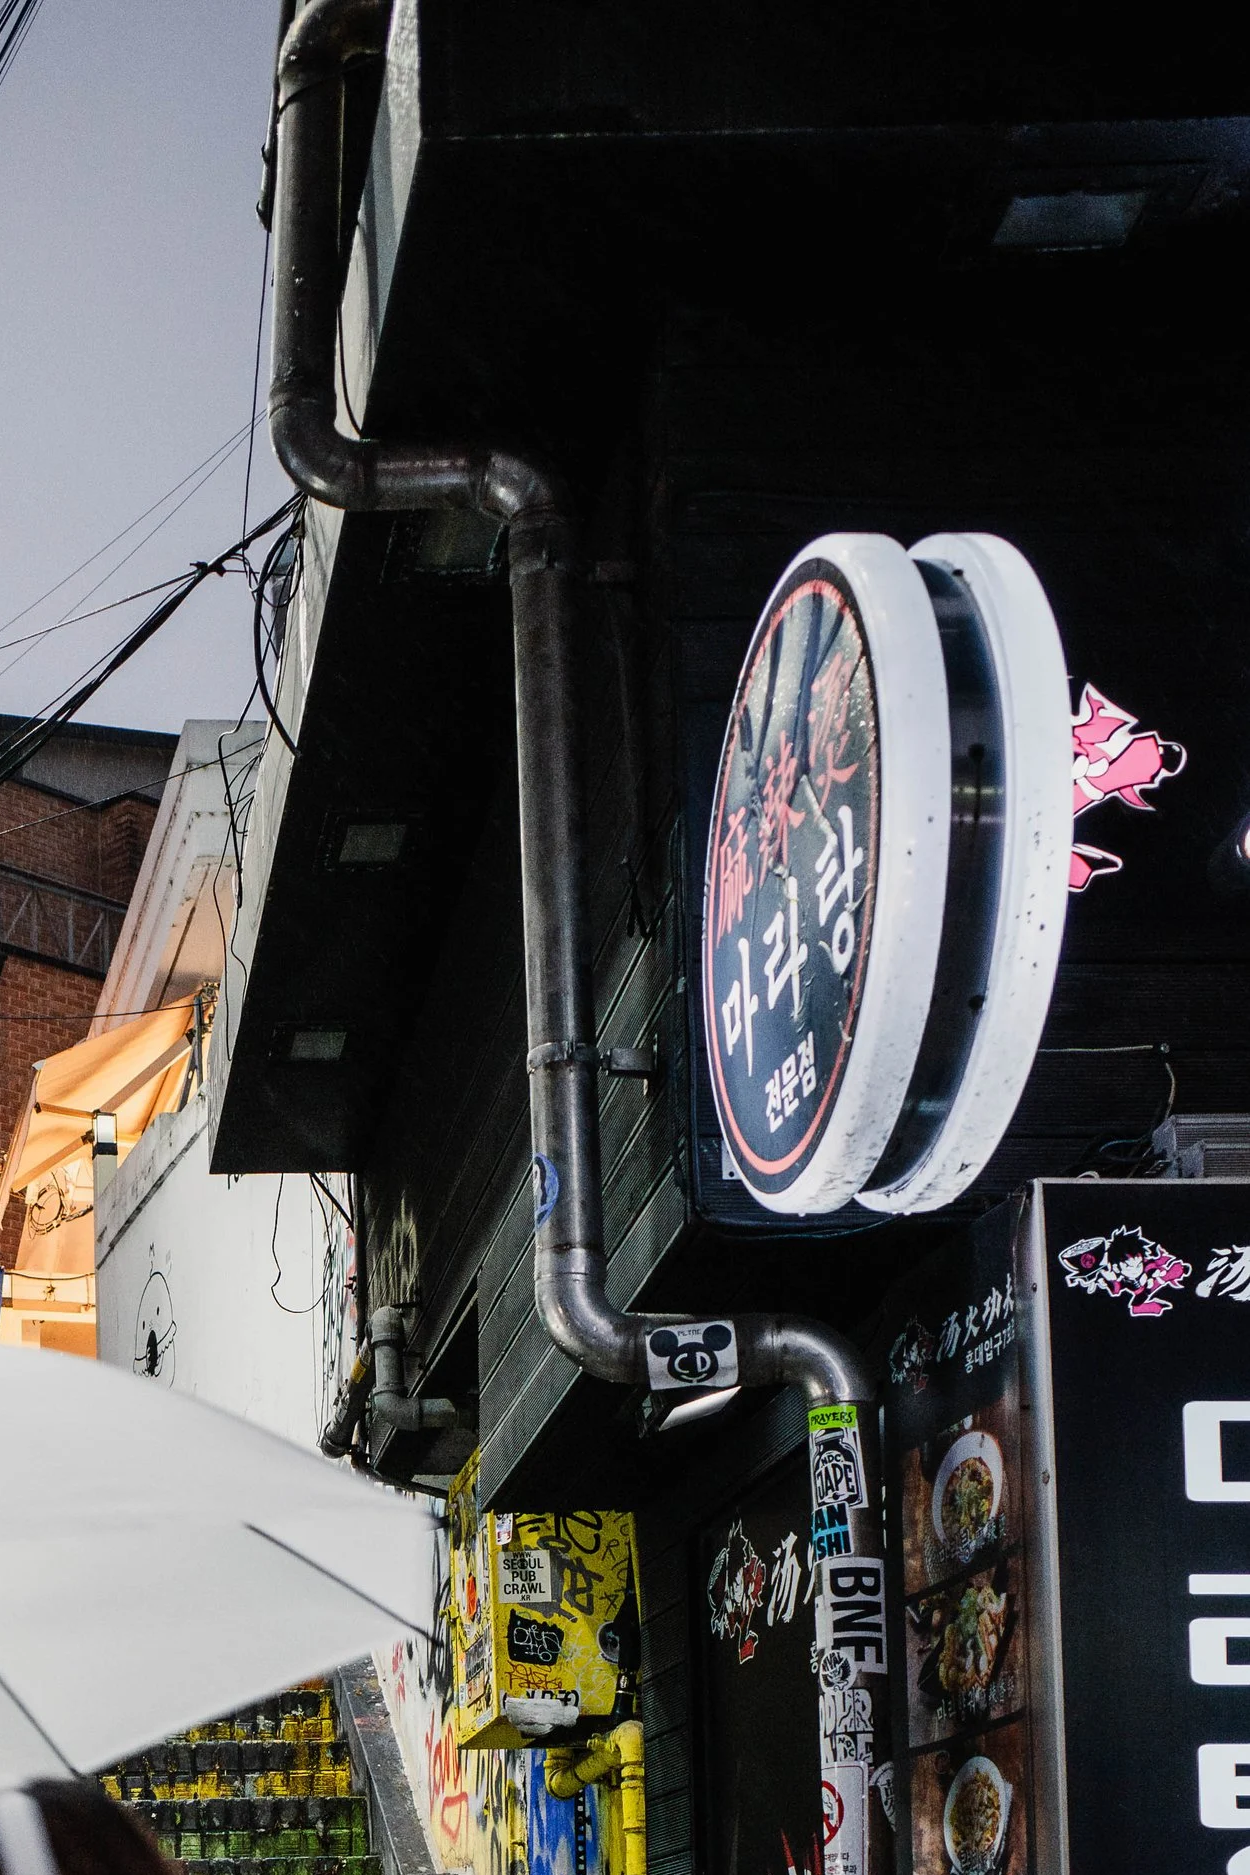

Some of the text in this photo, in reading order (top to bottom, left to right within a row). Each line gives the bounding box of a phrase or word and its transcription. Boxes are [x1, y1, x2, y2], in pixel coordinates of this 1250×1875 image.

[721, 805, 864, 1077] 마라탕
[765, 1032, 817, 1134] 전문점
[810, 1411, 853, 1426] PRAYERS
[817, 1463, 855, 1499] JAPE
[503, 1558, 544, 1571] SEOUL
[511, 1570, 536, 1582] PUB
[504, 1583, 546, 1594] CRAWL
